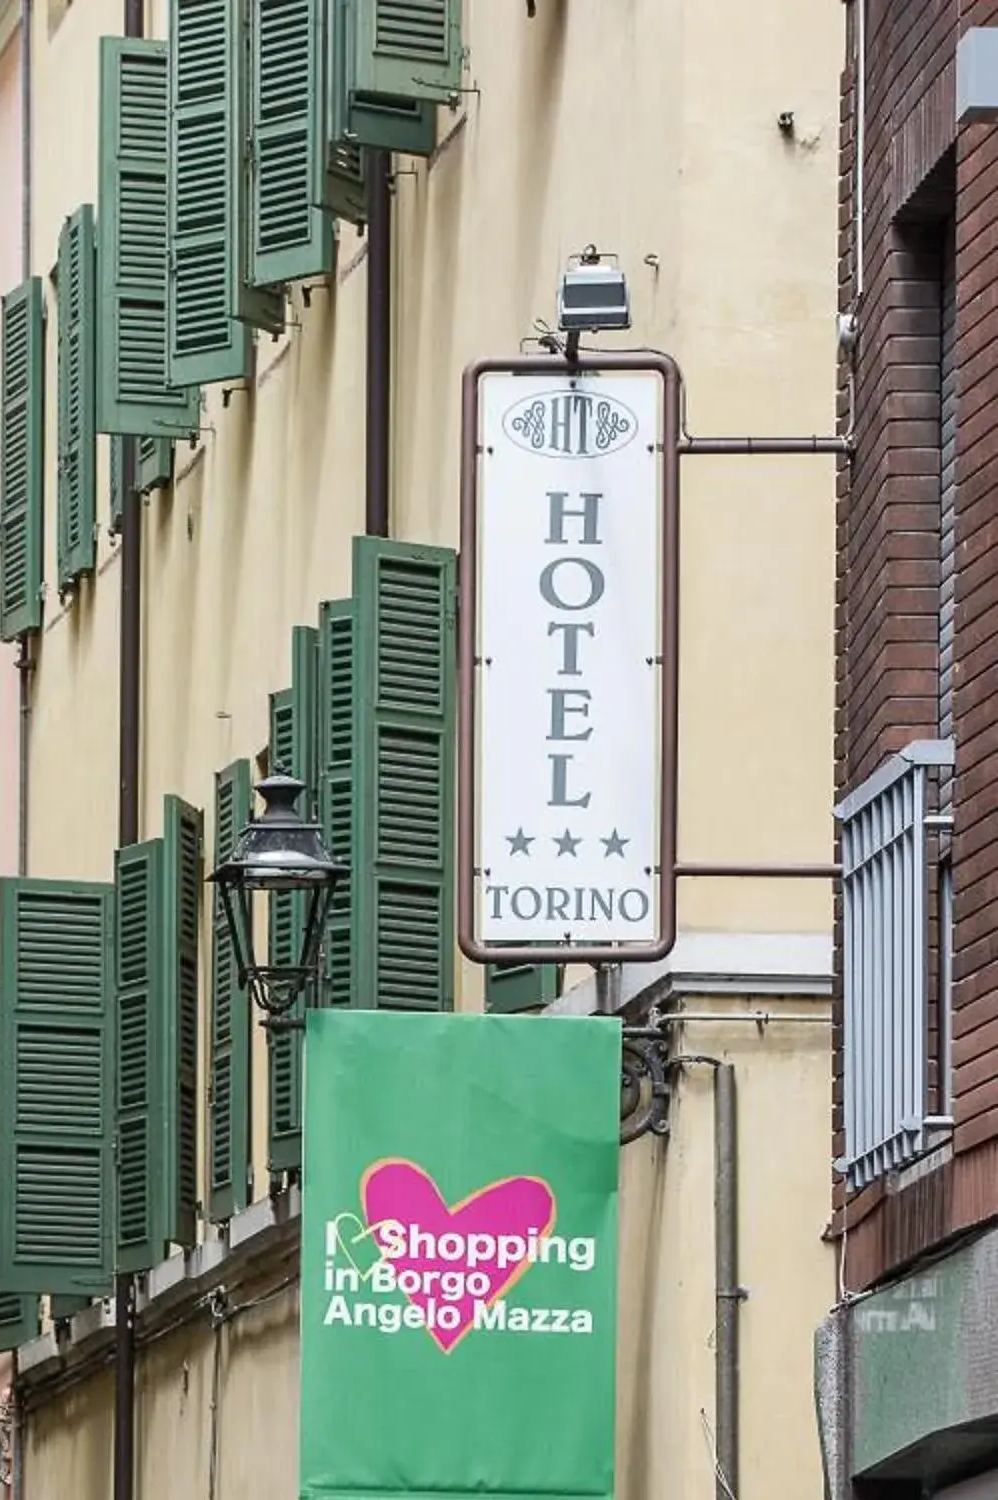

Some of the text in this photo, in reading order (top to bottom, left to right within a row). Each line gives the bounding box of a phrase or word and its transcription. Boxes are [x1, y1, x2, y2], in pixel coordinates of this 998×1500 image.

[539, 491, 606, 809] HOTEL
[486, 885, 650, 923] TORINO
[378, 1219, 596, 1271] Shopping
[323, 1261, 492, 1301] in Borgo
[323, 1296, 594, 1334] Angelo Mazza
